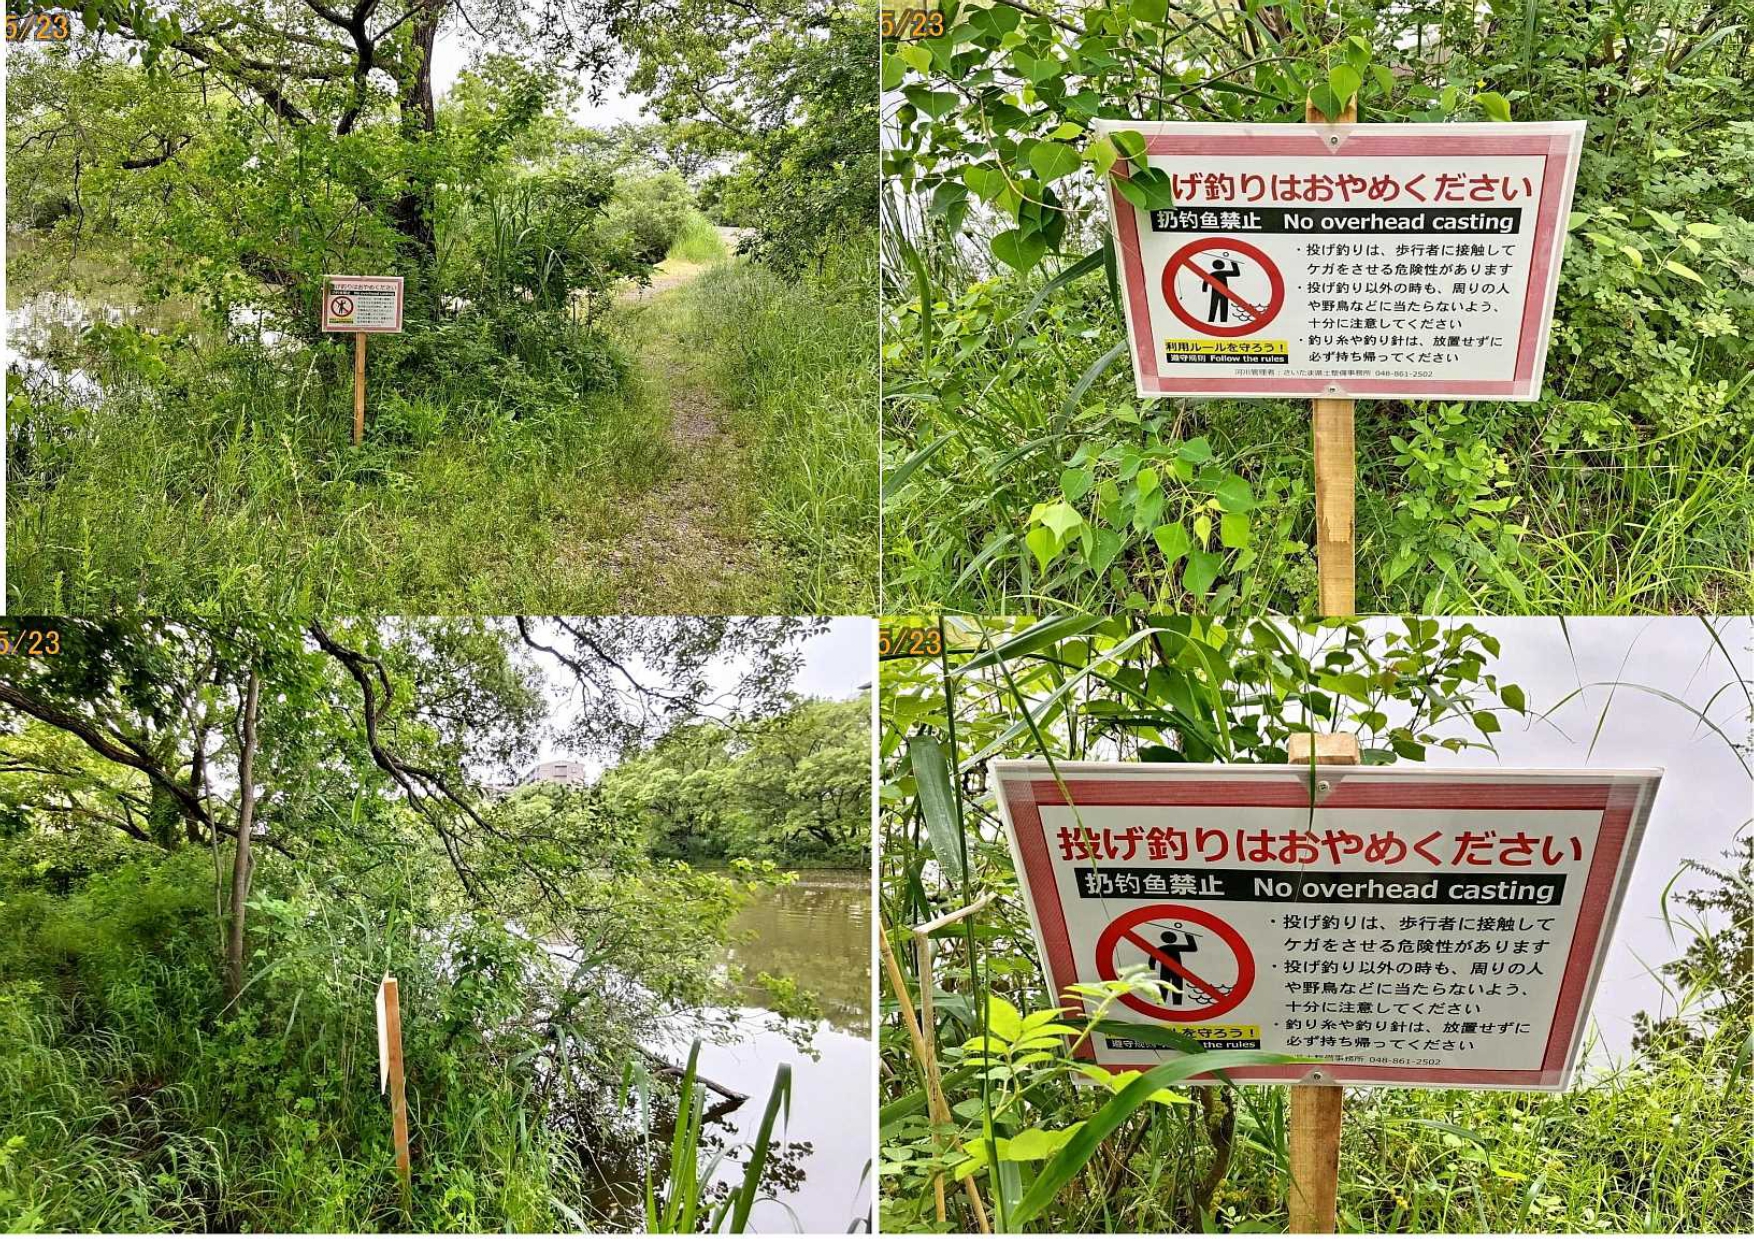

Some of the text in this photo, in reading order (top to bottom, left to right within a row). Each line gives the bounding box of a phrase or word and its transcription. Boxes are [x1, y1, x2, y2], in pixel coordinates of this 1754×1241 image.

[1172, 173, 1532, 202] げ釣りはおやめください
[1157, 210, 1514, 233] 扔钓鱼禁止 No overhead casting
[1307, 263, 1513, 276] ケガをさせる危険性があります
[1308, 318, 1462, 330] 十分に注意してください
[1210, 354, 1240, 363] Follow
[1243, 354, 1258, 363] the
[1260, 354, 1284, 363] rules
[1309, 352, 1459, 363] 必ず持ち帰ってください
[1057, 825, 1582, 867] 投げ釣りはおやめください
[1085, 872, 1555, 904] 扔钓鱼禁止 No overhead casting
[1284, 938, 1550, 954] ケガをさせる危険性があります
[1286, 1001, 1481, 1015] 十分に注意してください
[1226, 1041, 1256, 1049] rules
[1287, 1036, 1474, 1051] 必ず持ち帰ってください
